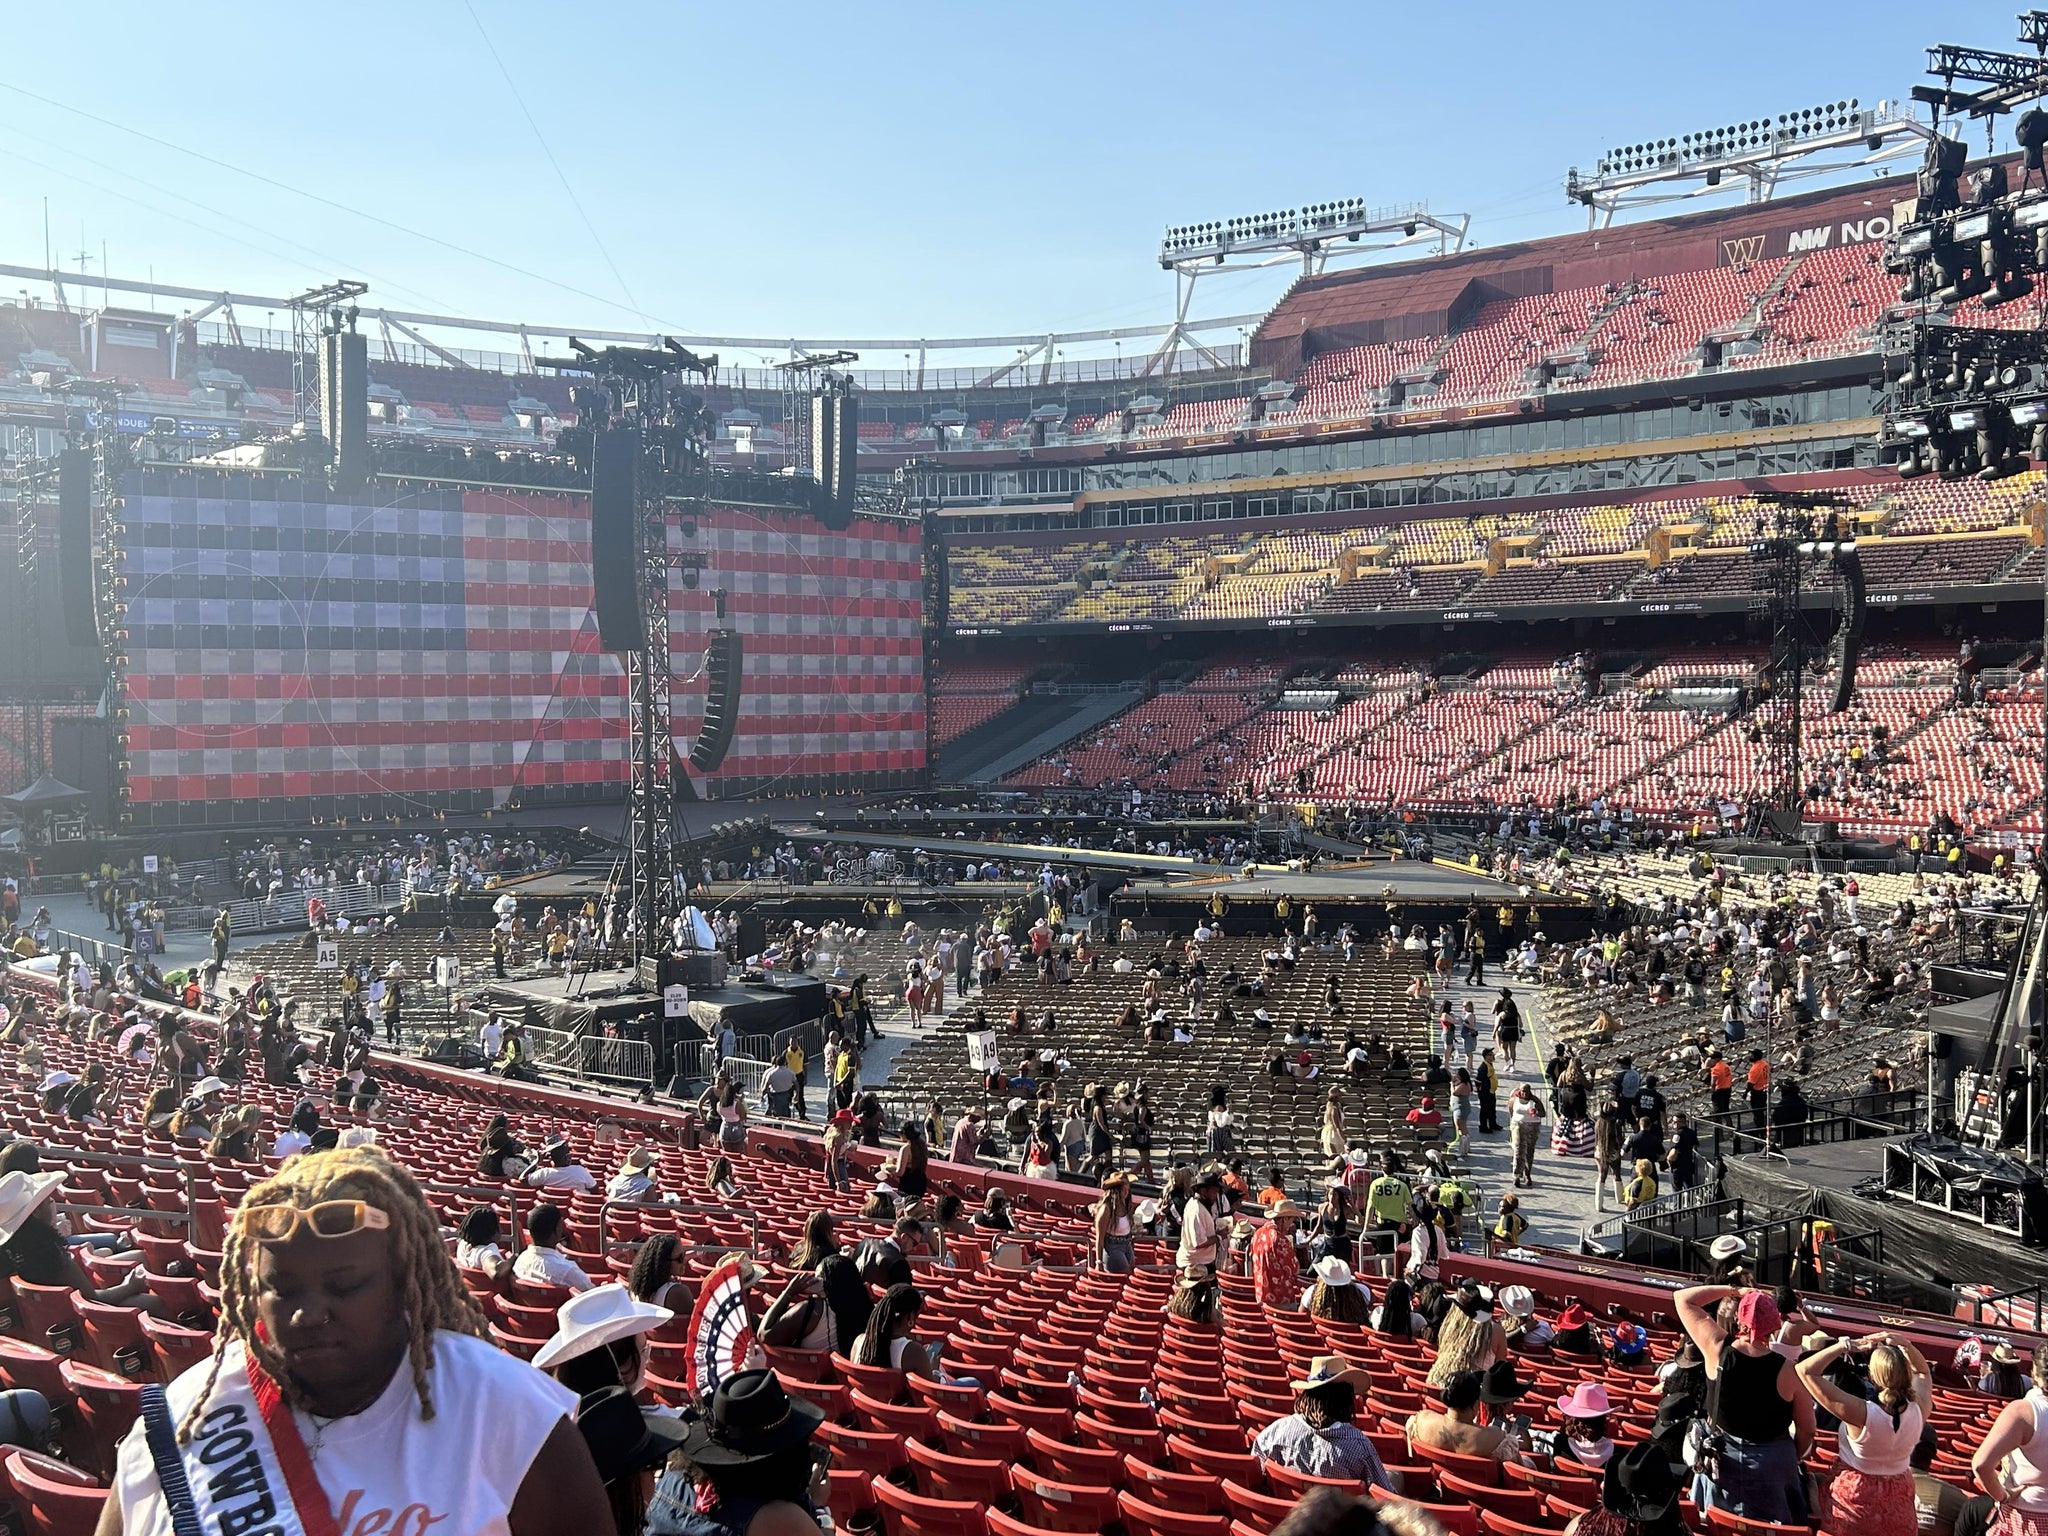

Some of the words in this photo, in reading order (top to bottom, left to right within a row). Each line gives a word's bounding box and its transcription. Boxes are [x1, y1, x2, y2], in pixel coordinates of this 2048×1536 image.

[1787, 225, 1832, 253] NW
[1841, 216, 1892, 244] NO
[836, 854, 896, 877] SALOON
[319, 949, 337, 963] A5
[447, 964, 459, 980] A7
[983, 1041, 995, 1061] A9
[1375, 1184, 1401, 1197] 367
[1805, 1304, 1835, 1313] ARK
[194, 1403, 286, 1536] COWB
